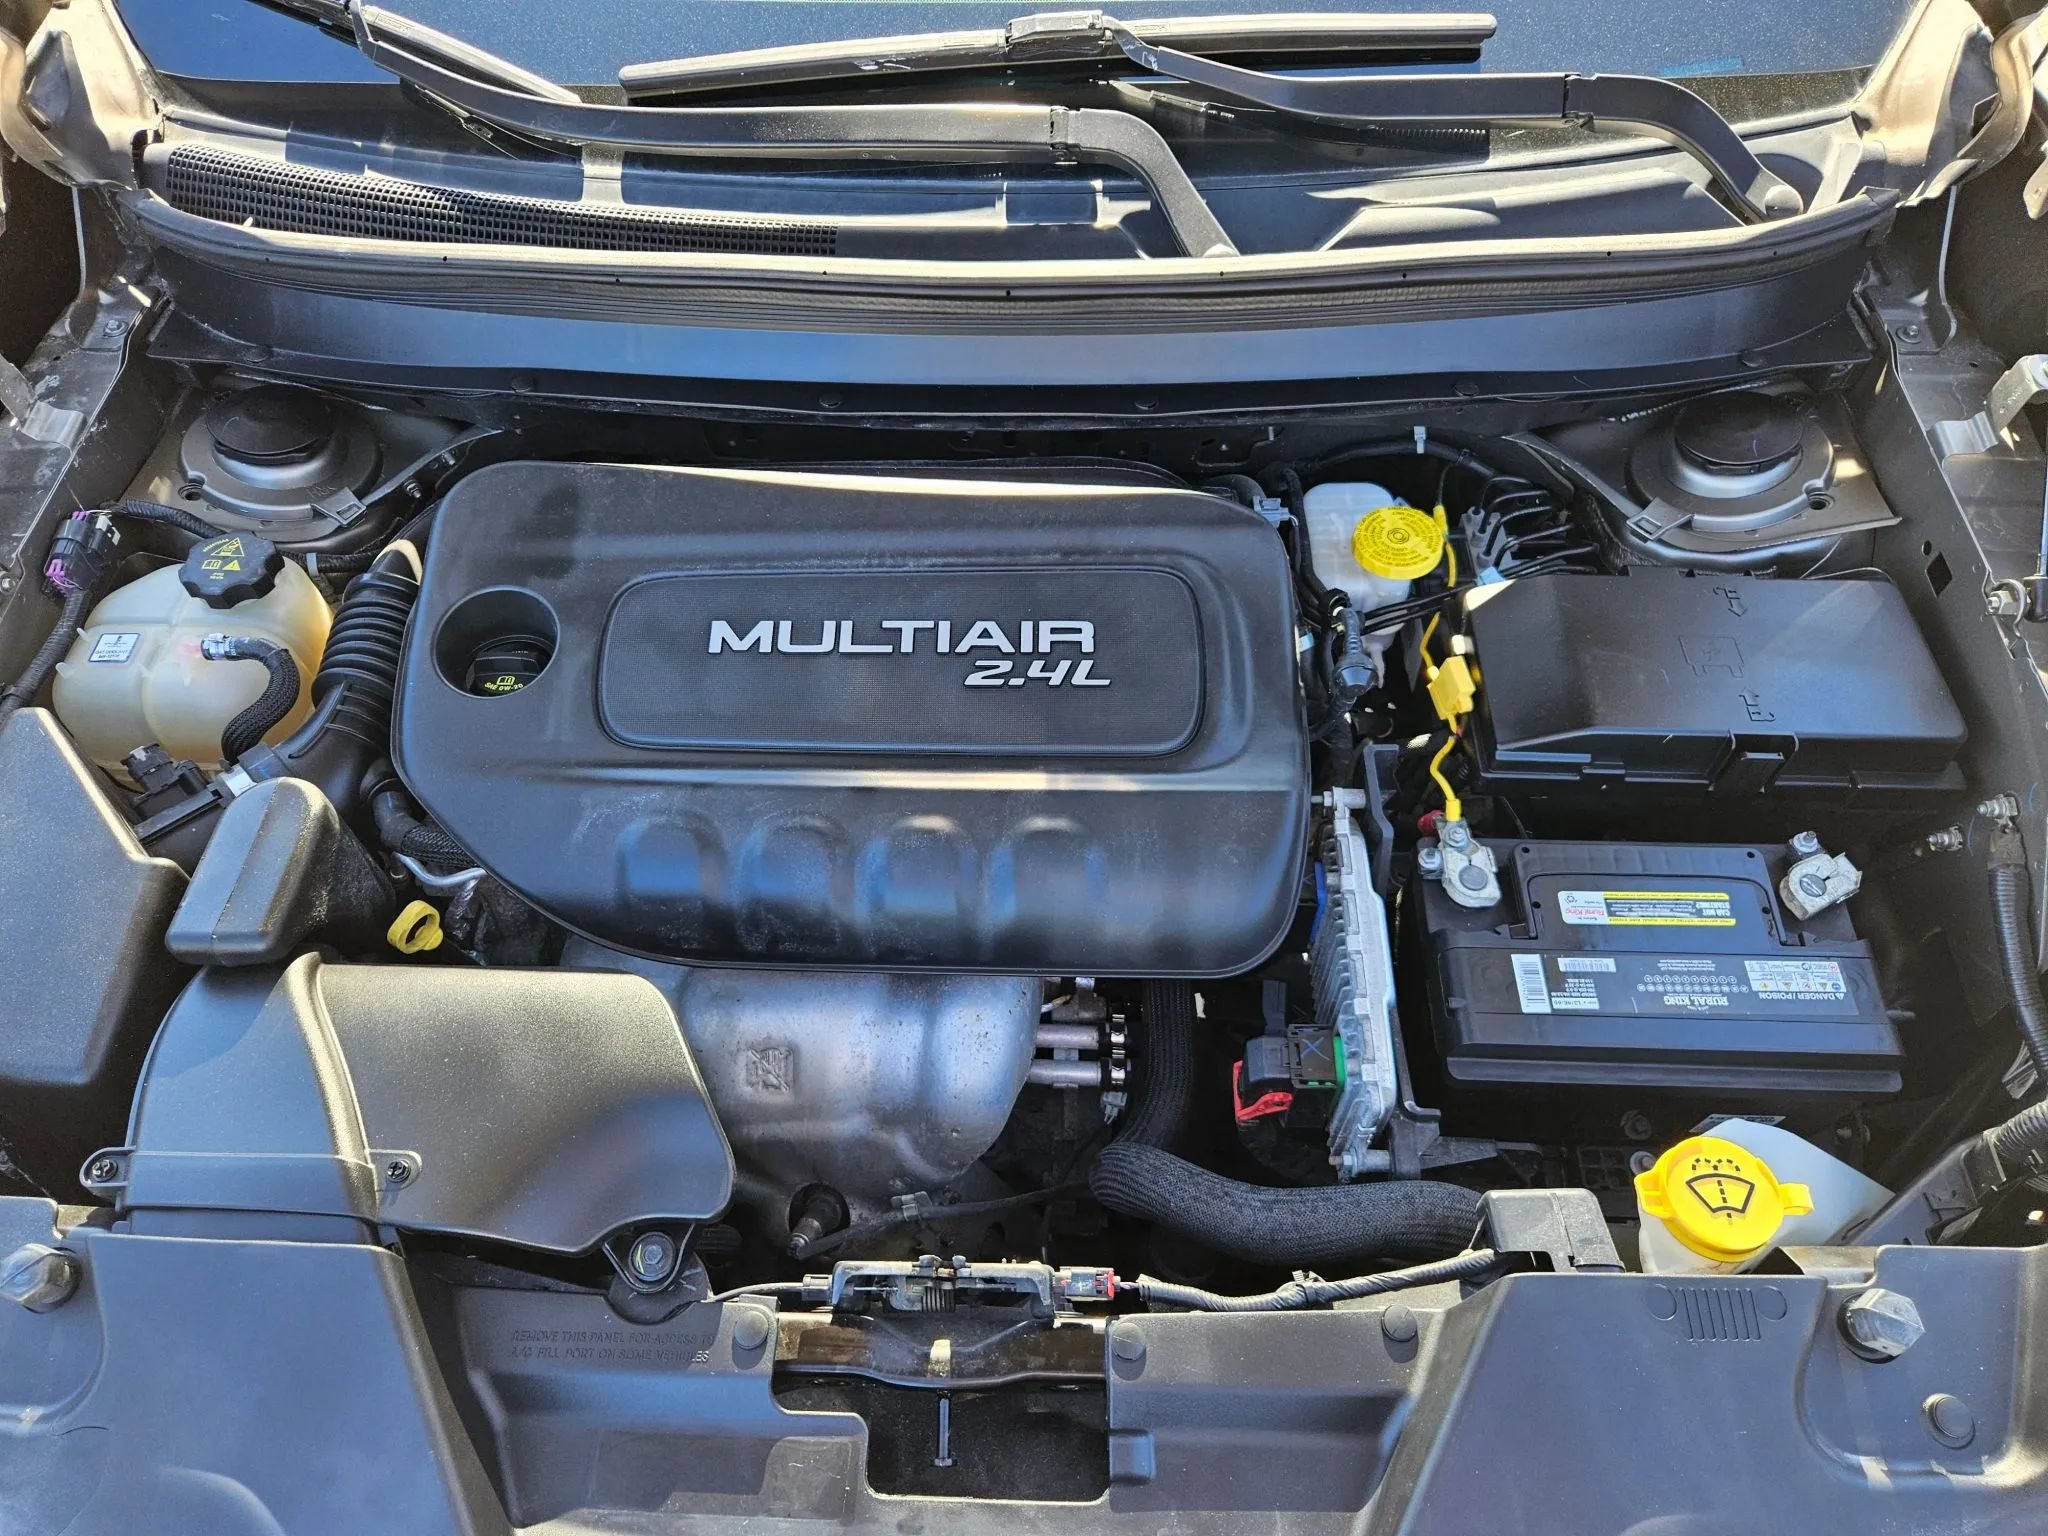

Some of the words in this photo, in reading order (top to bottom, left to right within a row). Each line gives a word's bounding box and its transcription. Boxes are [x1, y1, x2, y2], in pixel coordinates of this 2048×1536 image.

[707, 620, 1096, 654] MULTIAIR
[963, 659, 1111, 686] 2.4L
[484, 682, 498, 691] SAE
[1663, 995, 1690, 1005] KING
[1691, 996, 1729, 1006] RURAL
[1758, 992, 1792, 1000] POISON
[1796, 992, 1836, 1000] DANGER
[512, 1329, 559, 1341] REMOVE
[562, 1330, 587, 1342] THIS
[588, 1331, 625, 1343] PANEL
[629, 1332, 651, 1344] FOR
[654, 1333, 697, 1345] ACCESS
[701, 1334, 716, 1345] TO
[537, 1346, 559, 1359] FILL
[565, 1346, 594, 1359] PORT
[598, 1348, 615, 1360] ON
[618, 1348, 651, 1361] SOME
[656, 1349, 710, 1363] VEHICLES
